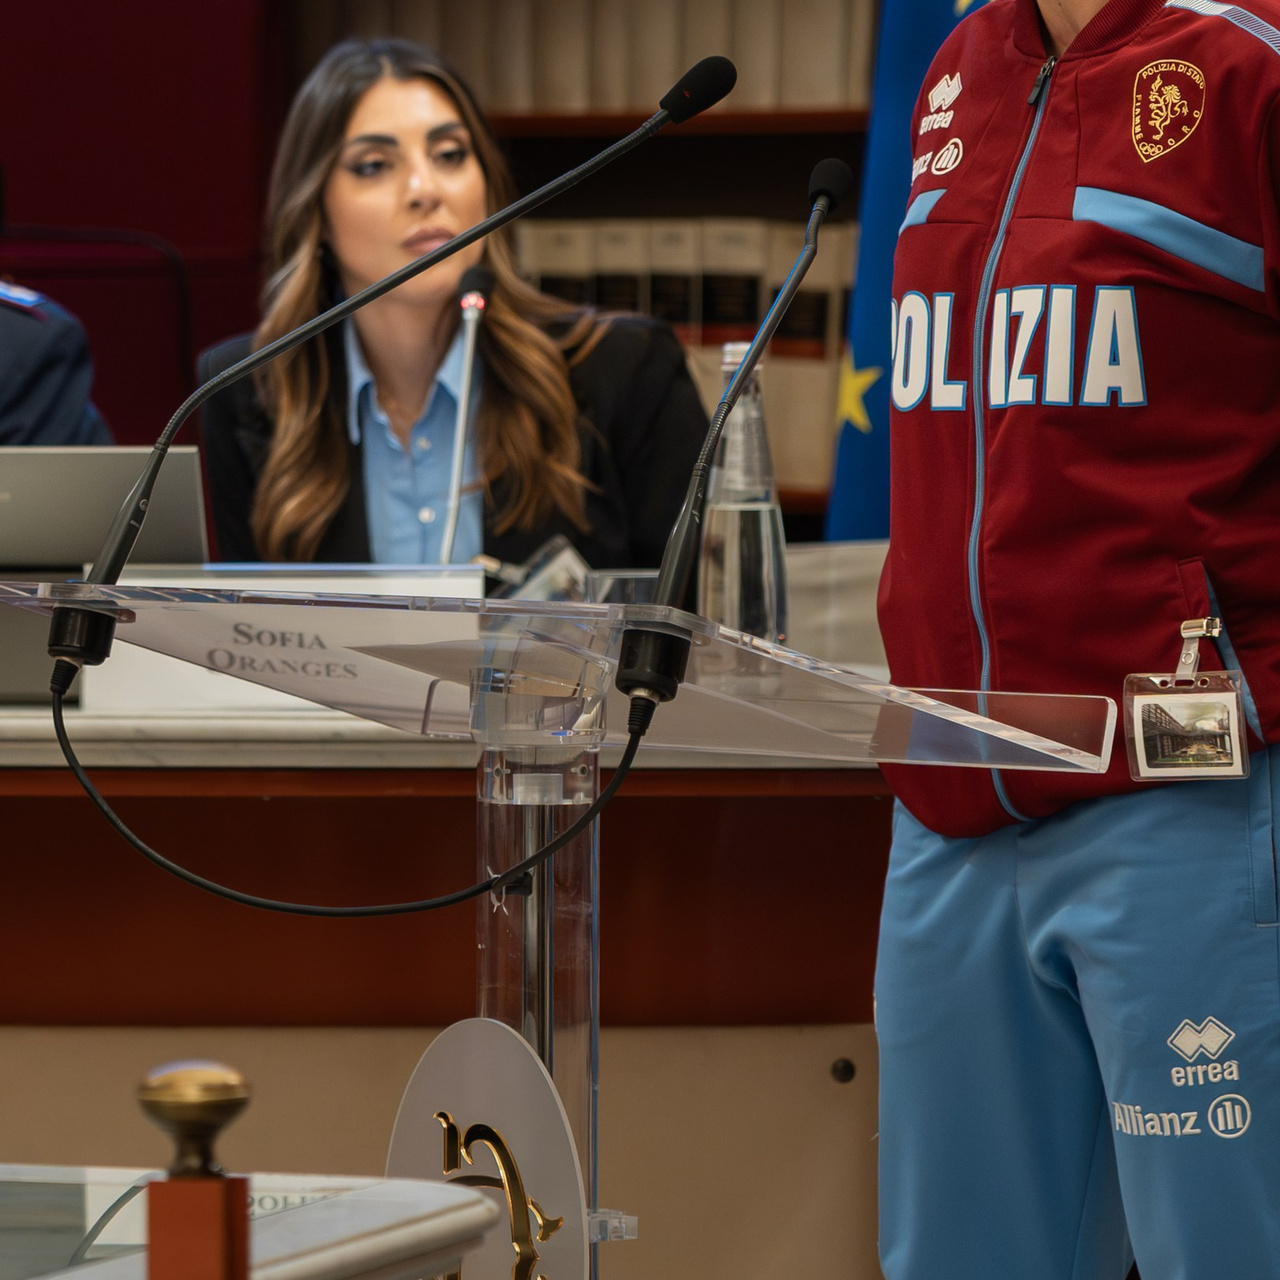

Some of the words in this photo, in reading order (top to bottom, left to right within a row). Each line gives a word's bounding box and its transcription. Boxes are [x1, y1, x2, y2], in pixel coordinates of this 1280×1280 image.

[1142, 63, 1177, 80] POLIZIA
[1177, 64, 1188, 74] DI
[1134, 93, 1145, 141] FIAMME
[891, 284, 1148, 412] OLIZIA
[232, 621, 327, 651] SOFIA
[206, 647, 360, 680] ORANGES
[1112, 1100, 1202, 1137] Allianz
